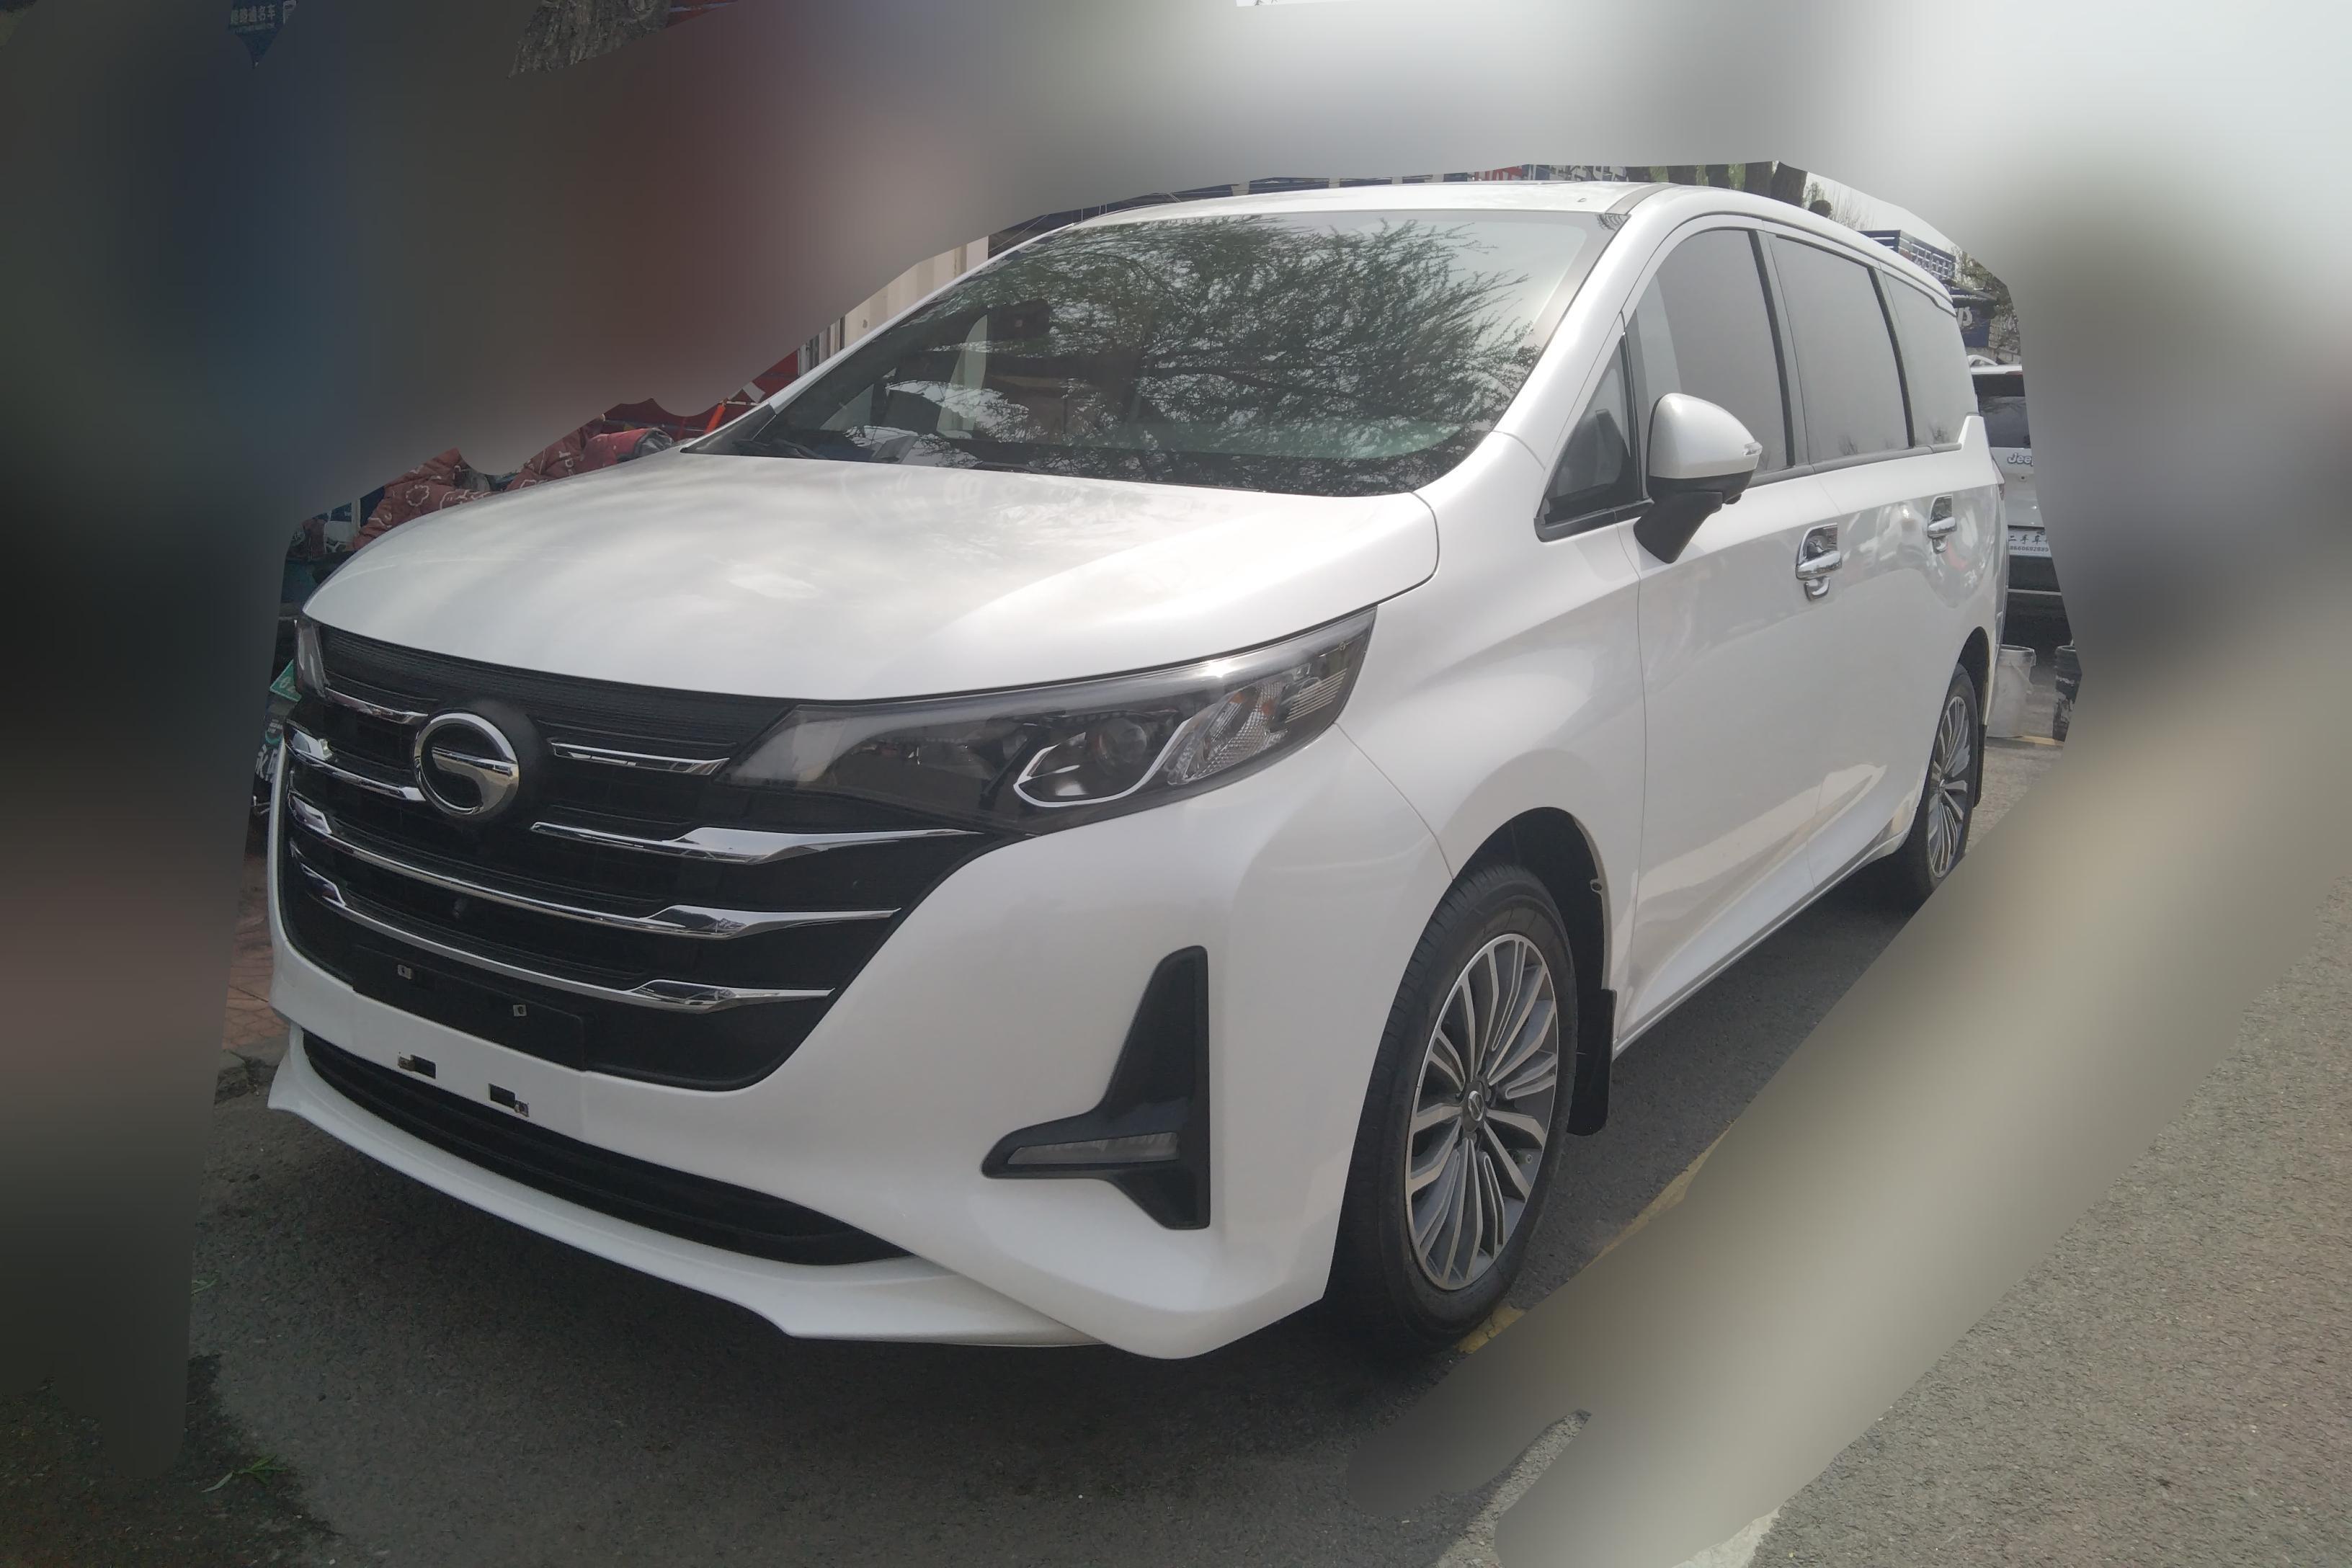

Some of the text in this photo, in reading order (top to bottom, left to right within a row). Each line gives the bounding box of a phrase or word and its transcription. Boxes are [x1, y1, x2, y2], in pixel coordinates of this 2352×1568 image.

[2007, 453, 2034, 467] Jee
[2008, 534, 2048, 545] 二手车
